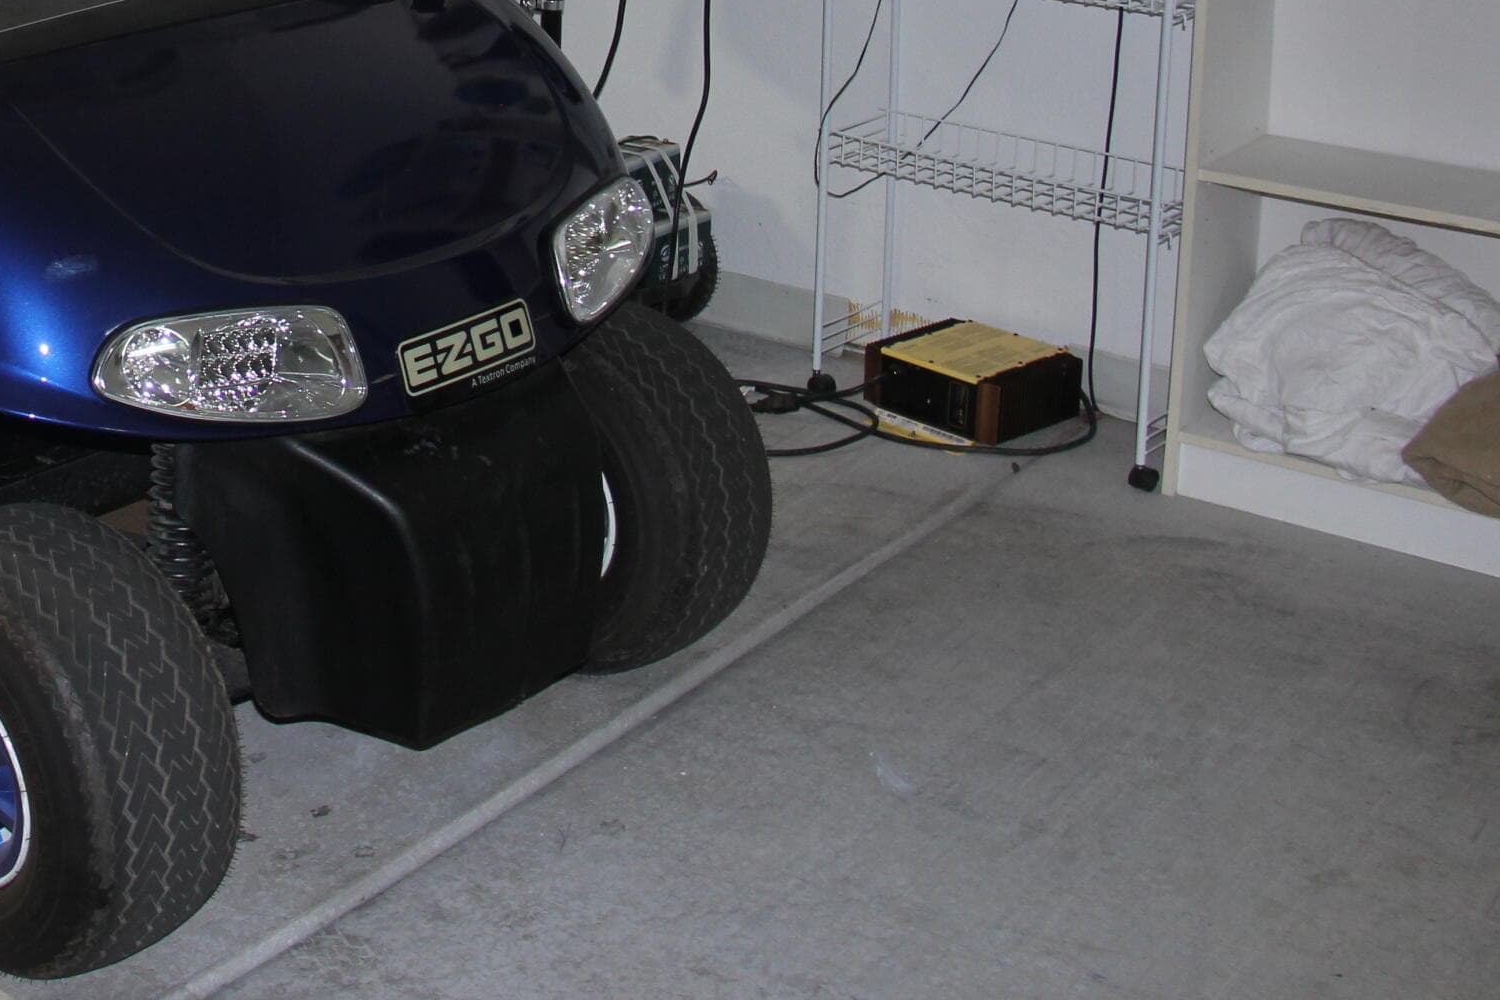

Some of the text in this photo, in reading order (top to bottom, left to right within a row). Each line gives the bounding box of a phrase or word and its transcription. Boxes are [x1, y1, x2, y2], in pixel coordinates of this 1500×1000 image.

[471, 356, 536, 388] A Textron Company
